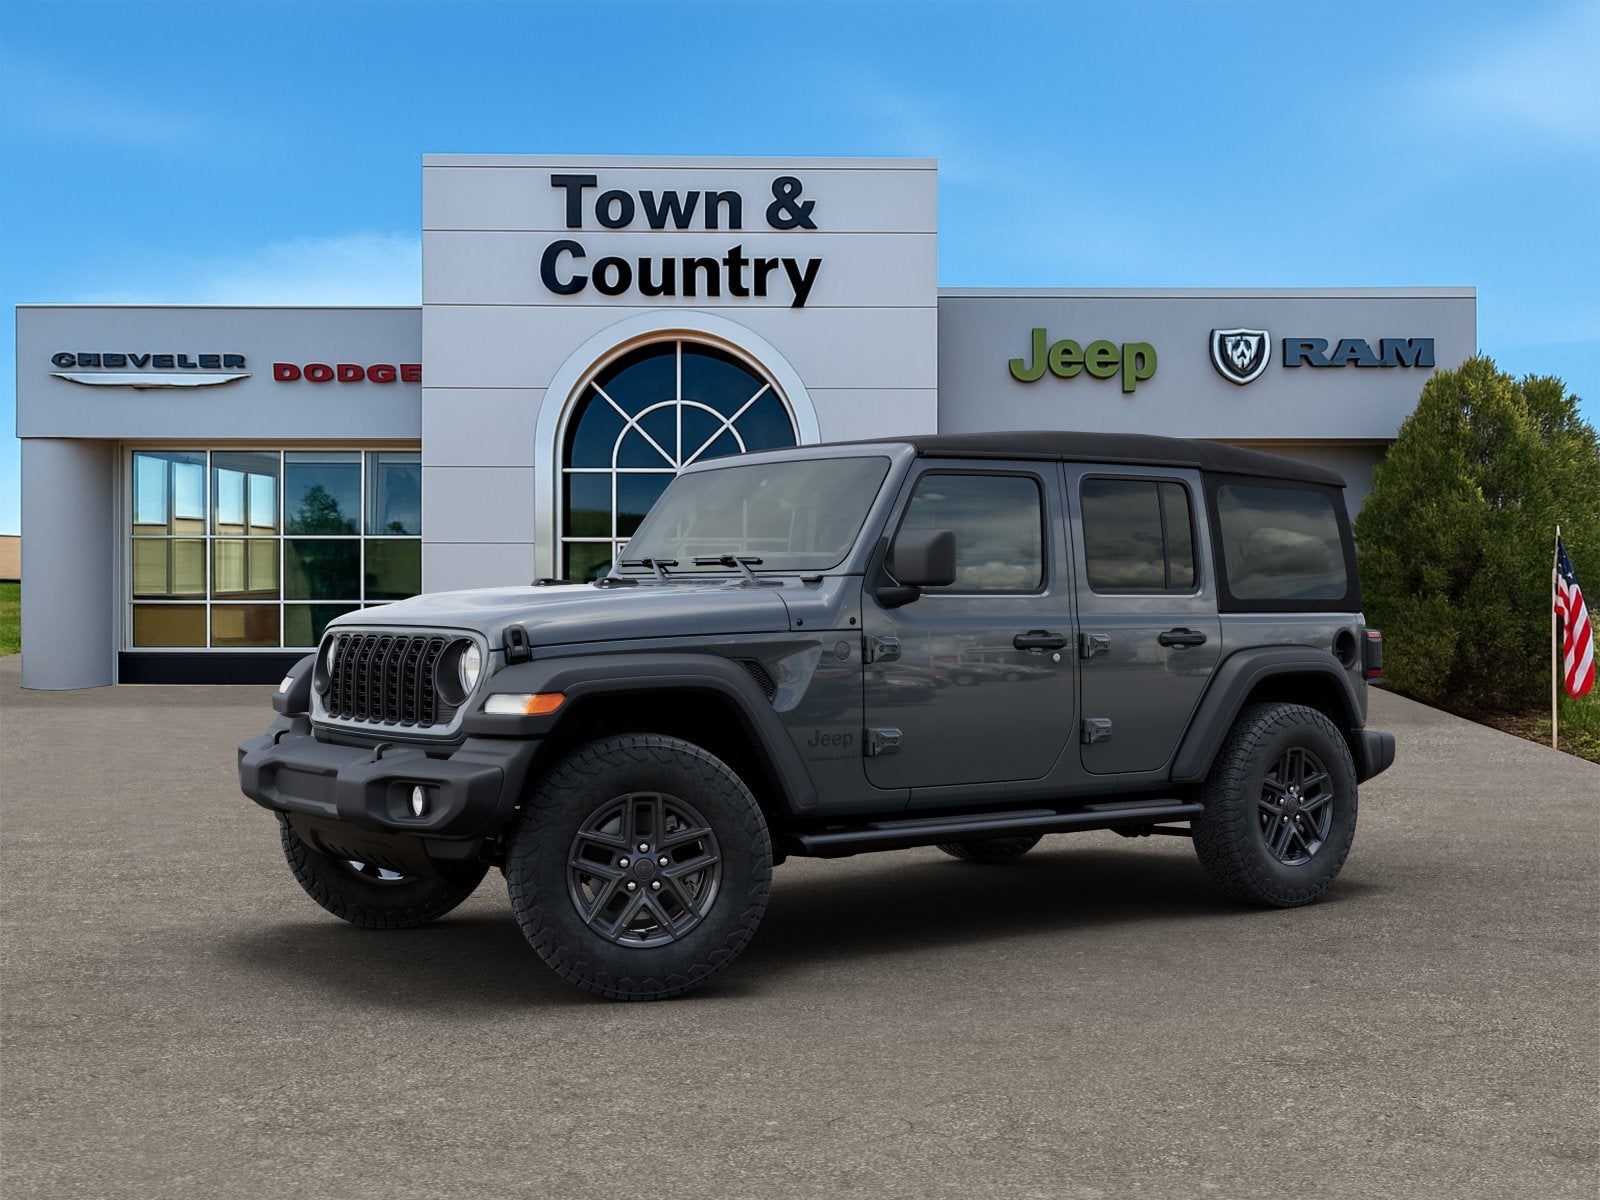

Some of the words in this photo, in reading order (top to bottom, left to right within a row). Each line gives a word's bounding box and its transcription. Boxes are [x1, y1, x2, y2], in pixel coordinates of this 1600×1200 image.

[551, 173, 743, 229] Town
[765, 175, 818, 230] &
[540, 239, 822, 308] Country
[273, 362, 422, 383] DODGE
[1008, 327, 1158, 393] Jeep
[1282, 337, 1436, 368] RAM
[807, 729, 854, 749] Jeep
